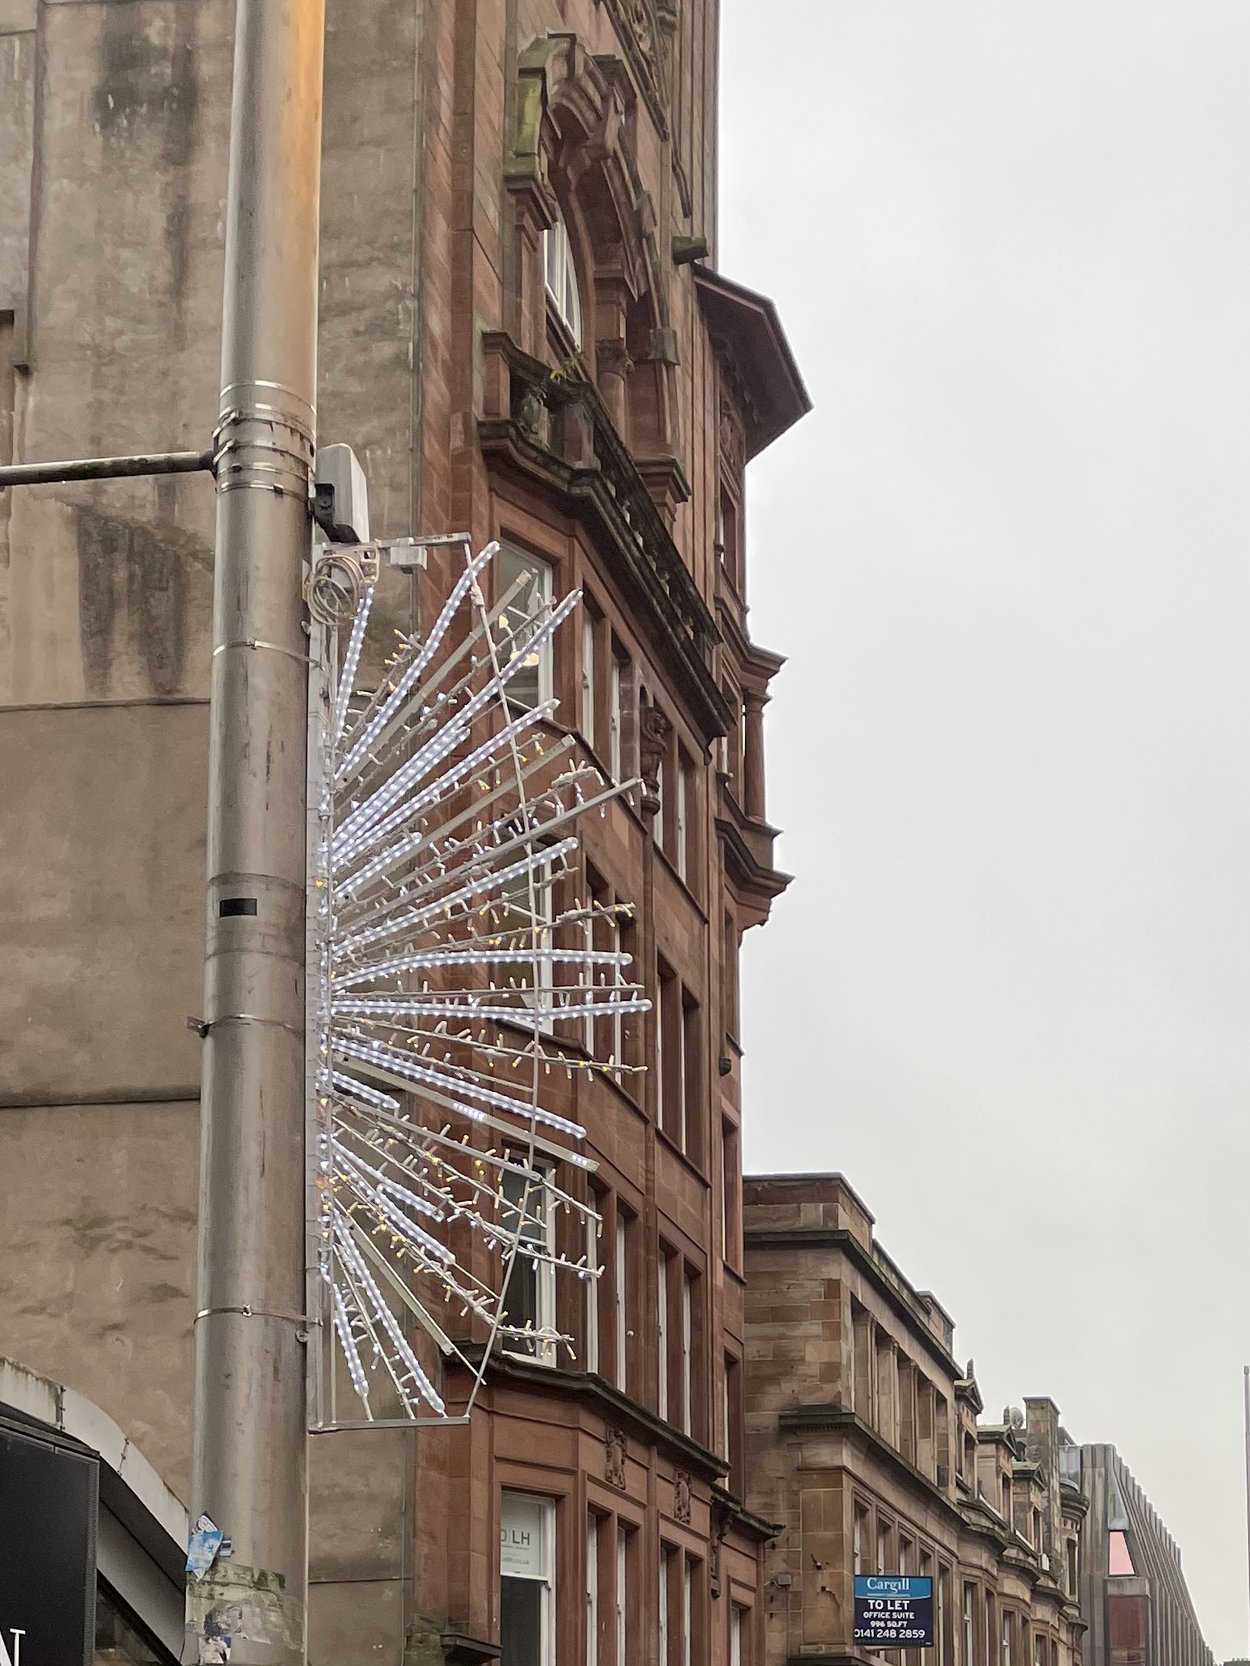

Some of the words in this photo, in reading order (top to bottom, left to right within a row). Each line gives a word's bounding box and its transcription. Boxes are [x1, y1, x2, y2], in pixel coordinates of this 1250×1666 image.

[867, 1577, 910, 1594] Cargill
[868, 1600, 883, 1610] TO
[887, 1600, 910, 1610] LET
[877, 1629, 897, 1638] 248
[899, 1629, 926, 1639] 2859
